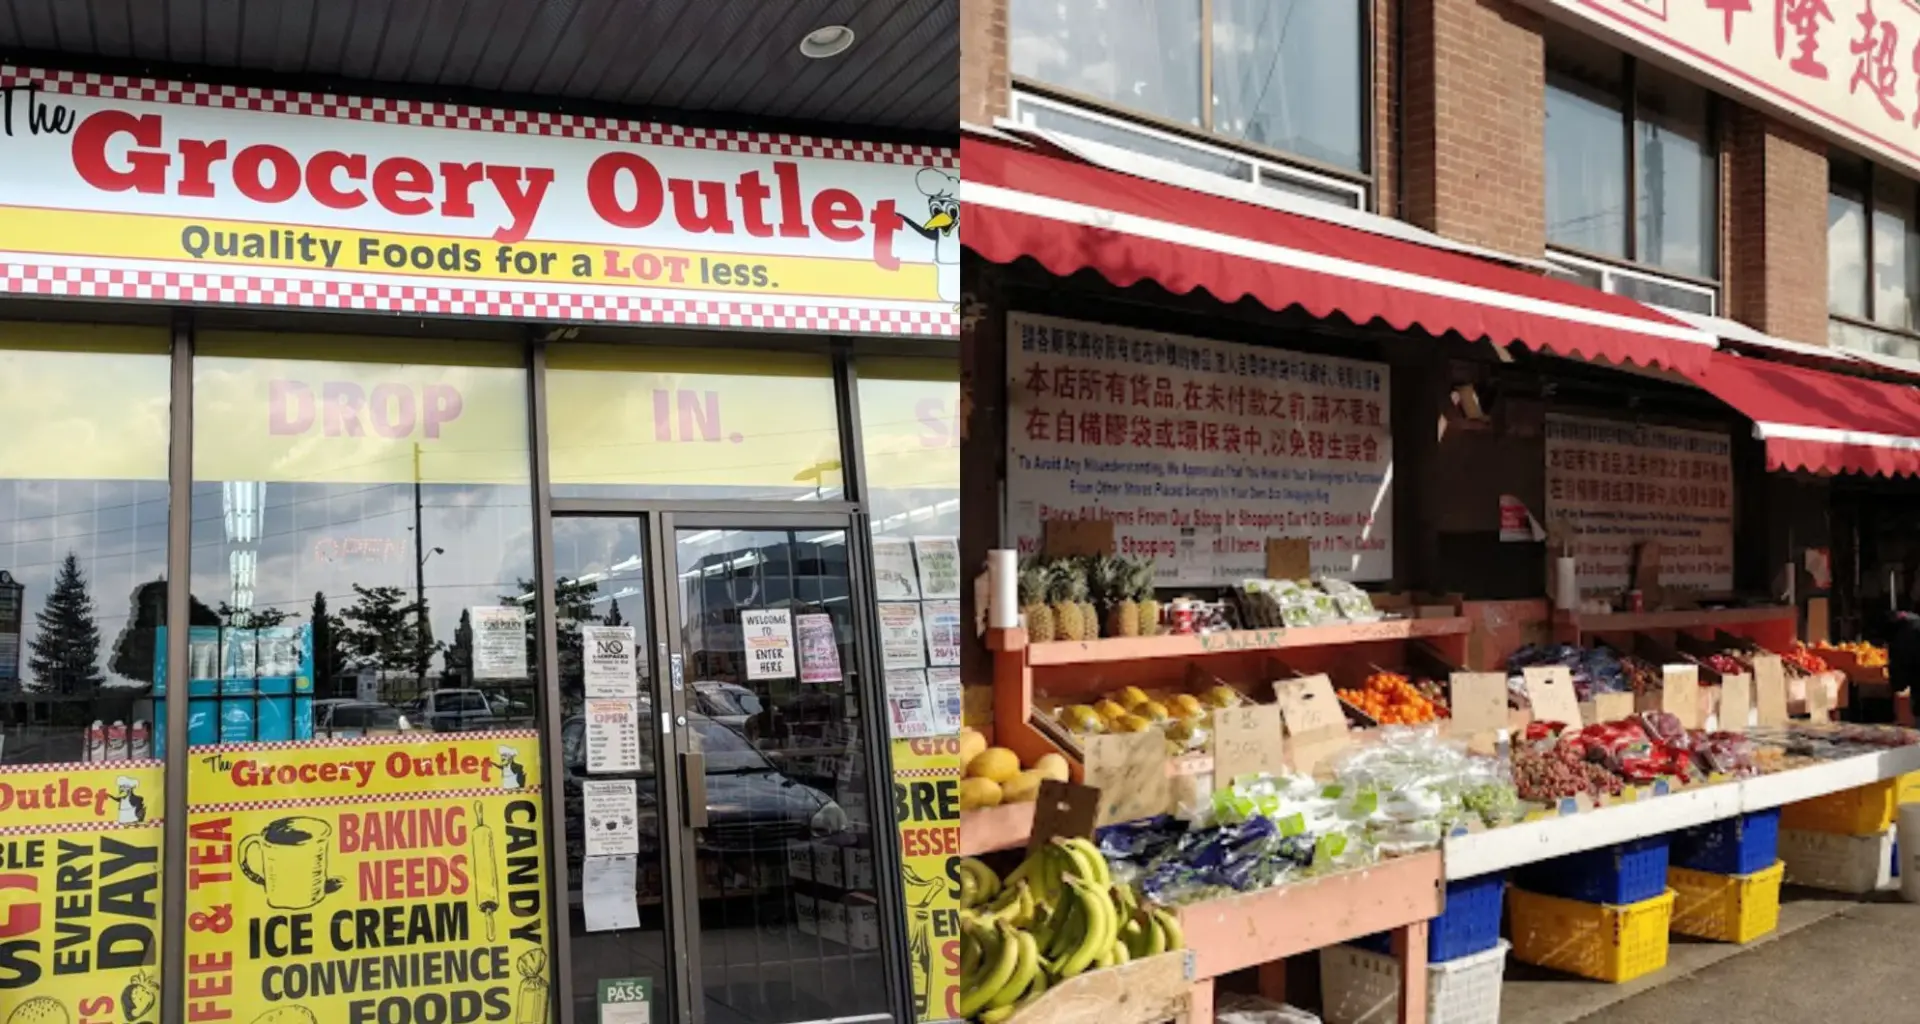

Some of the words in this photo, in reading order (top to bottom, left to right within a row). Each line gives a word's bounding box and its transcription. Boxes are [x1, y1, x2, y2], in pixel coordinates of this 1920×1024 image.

[0, 84, 75, 137] The
[71, 109, 554, 244] Grocery
[587, 151, 904, 271] Outlet
[181, 224, 342, 268] Quality
[358, 237, 481, 273] Foods
[494, 245, 557, 276] for
[571, 253, 592, 277] a
[603, 249, 689, 284] LOT
[700, 256, 779, 289] less.
[267, 379, 464, 440] DROP
[652, 388, 745, 444] IN.
[1034, 455, 1061, 470] Avoid
[1138, 506, 1167, 526] From
[1121, 535, 1176, 558] Shopping
[746, 614, 787, 625] WELCOME
[762, 626, 772, 636] TO
[755, 648, 785, 660] ENTER
[760, 661, 783, 673] HERE
[594, 712, 629, 724] OPEN
[203, 753, 234, 776] The
[231, 757, 375, 788] Grocery
[386, 748, 493, 782] Outlet
[338, 806, 467, 854] BAKING
[189, 817, 232, 890] TEA
[504, 800, 543, 946] CANDY
[358, 855, 468, 902] NEEDS
[53, 839, 93, 976] EVERY
[97, 836, 158, 970] DAY
[188, 903, 233, 934] &
[250, 913, 313, 960] ICE
[330, 902, 469, 952] CREAM
[262, 946, 510, 1001] CONVENIENCE
[607, 985, 644, 1002] PASS
[349, 986, 512, 1024] FOODS
